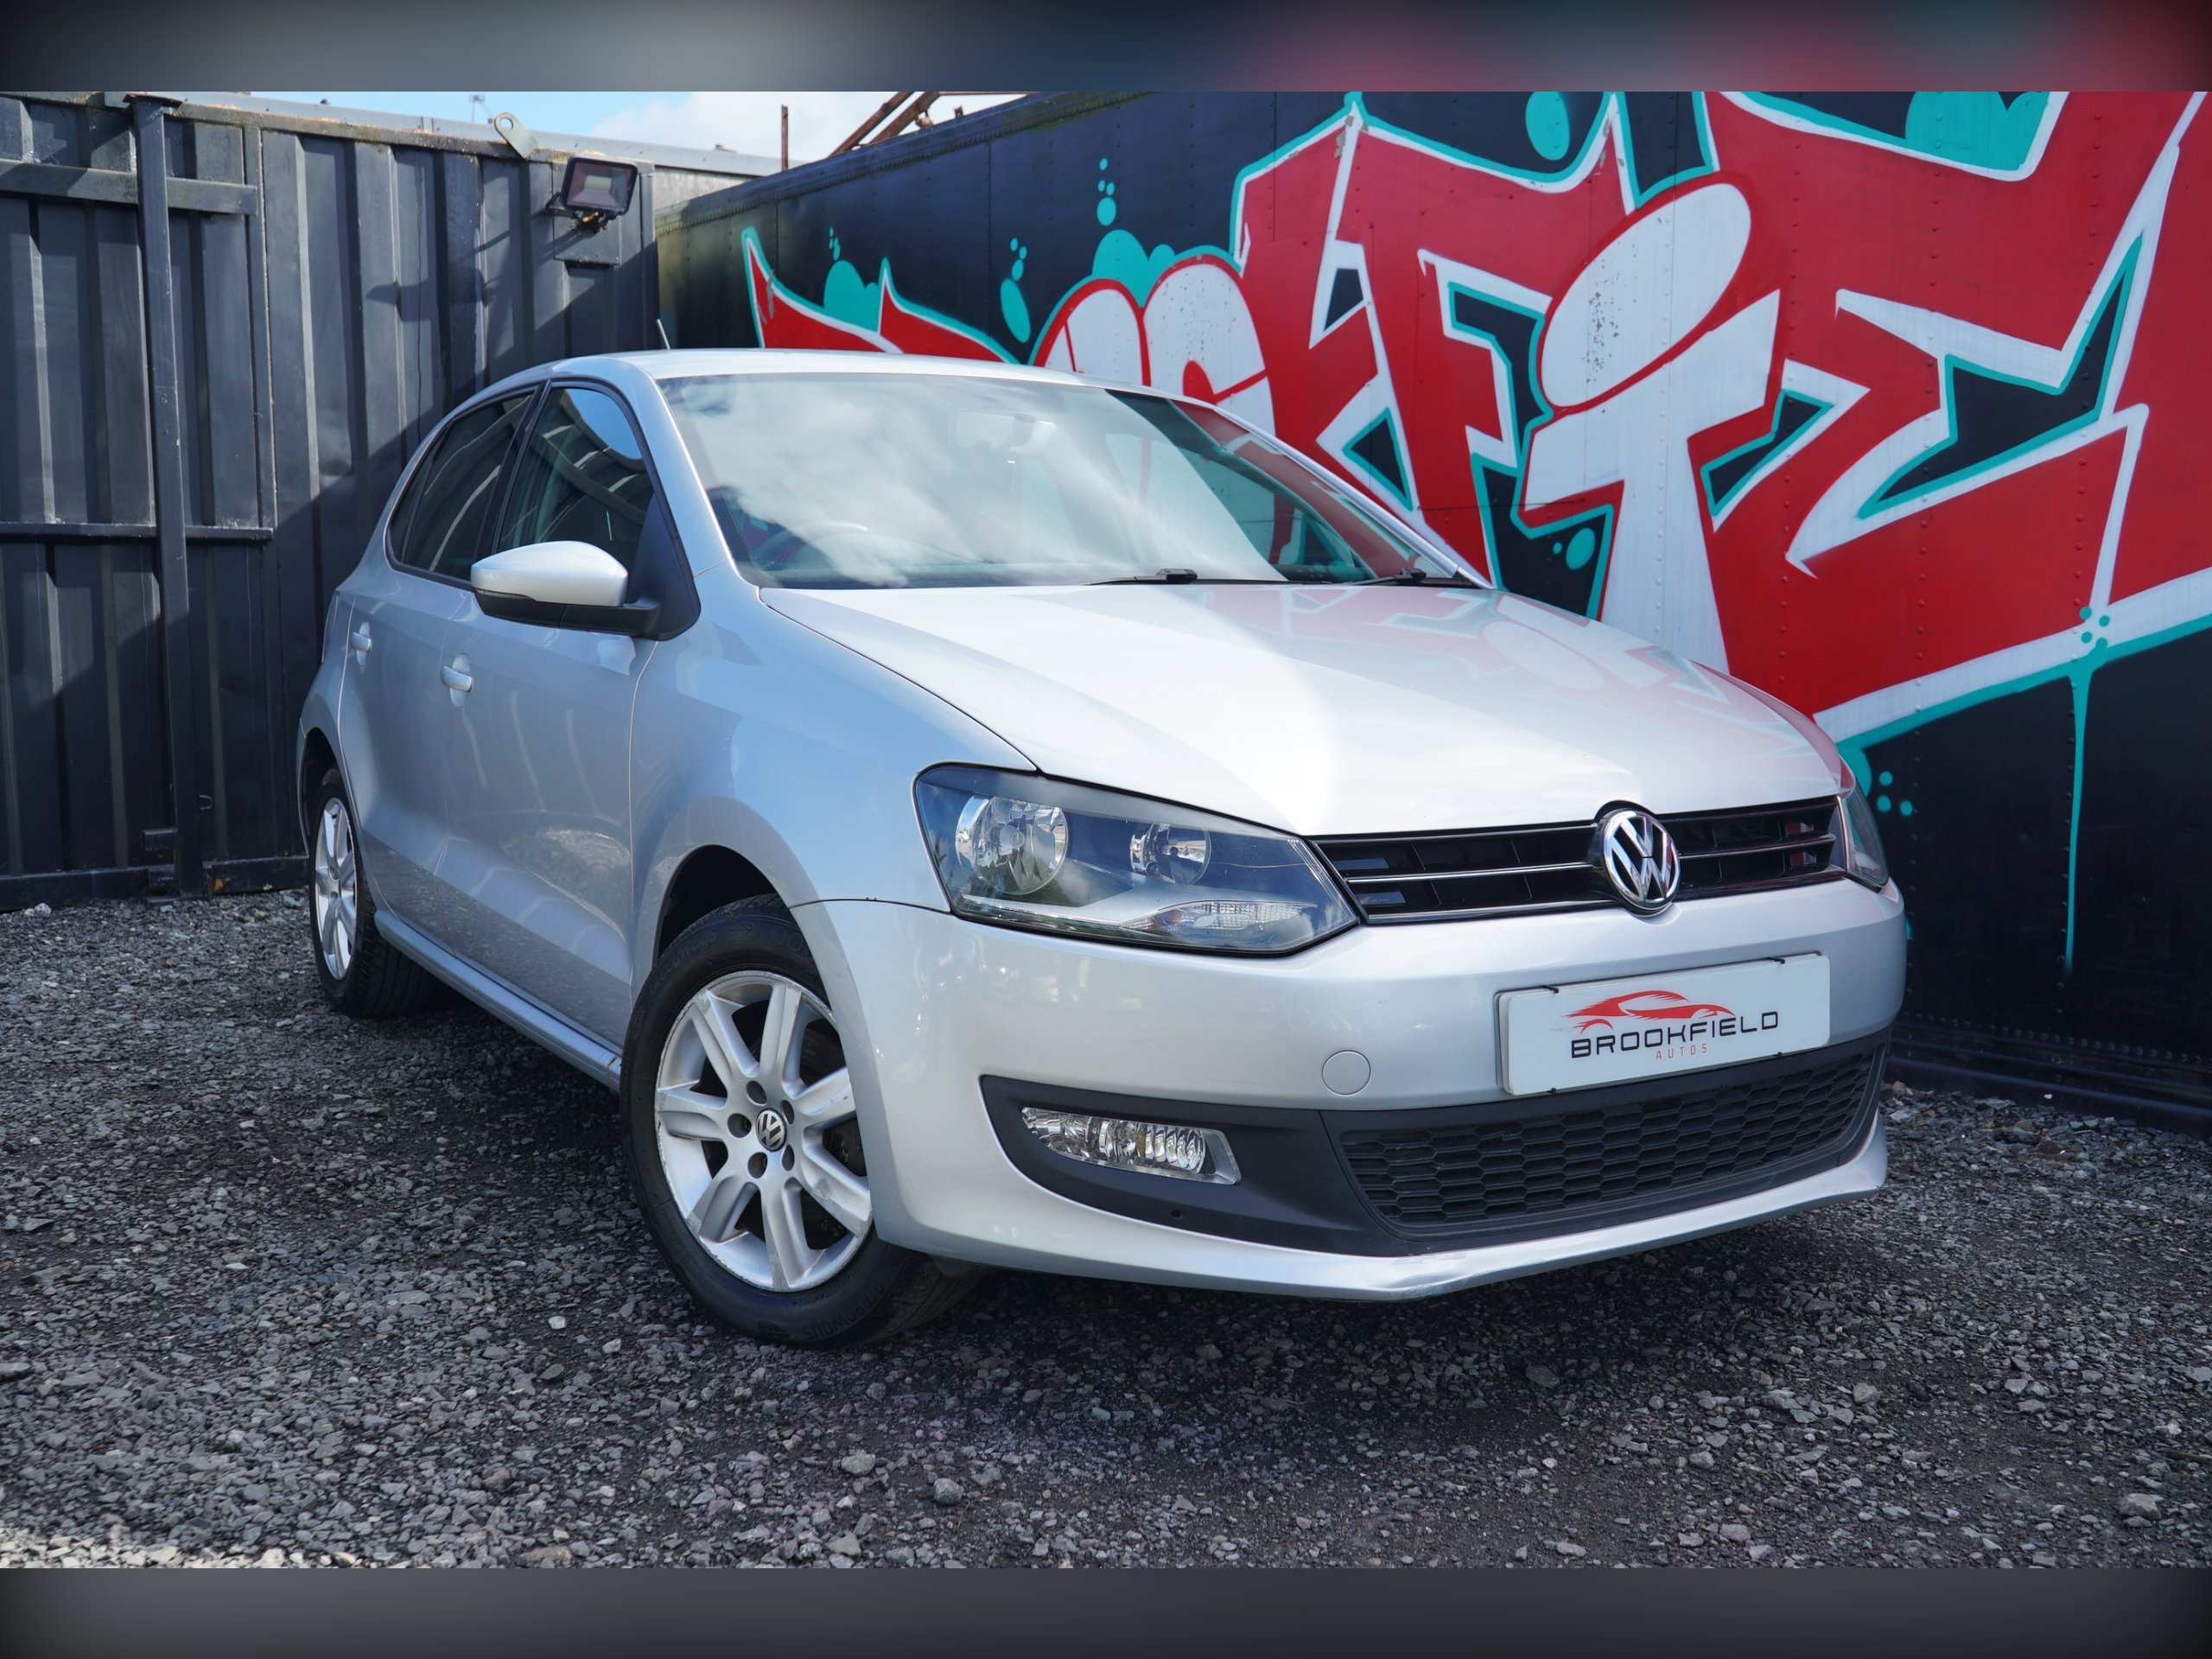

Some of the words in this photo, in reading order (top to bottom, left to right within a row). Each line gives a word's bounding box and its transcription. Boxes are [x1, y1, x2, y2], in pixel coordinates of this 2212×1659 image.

[1604, 810, 1680, 908] VW
[1571, 1011, 1778, 1058] BROOKFIELD
[1656, 1043, 1708, 1060] AUTOS
